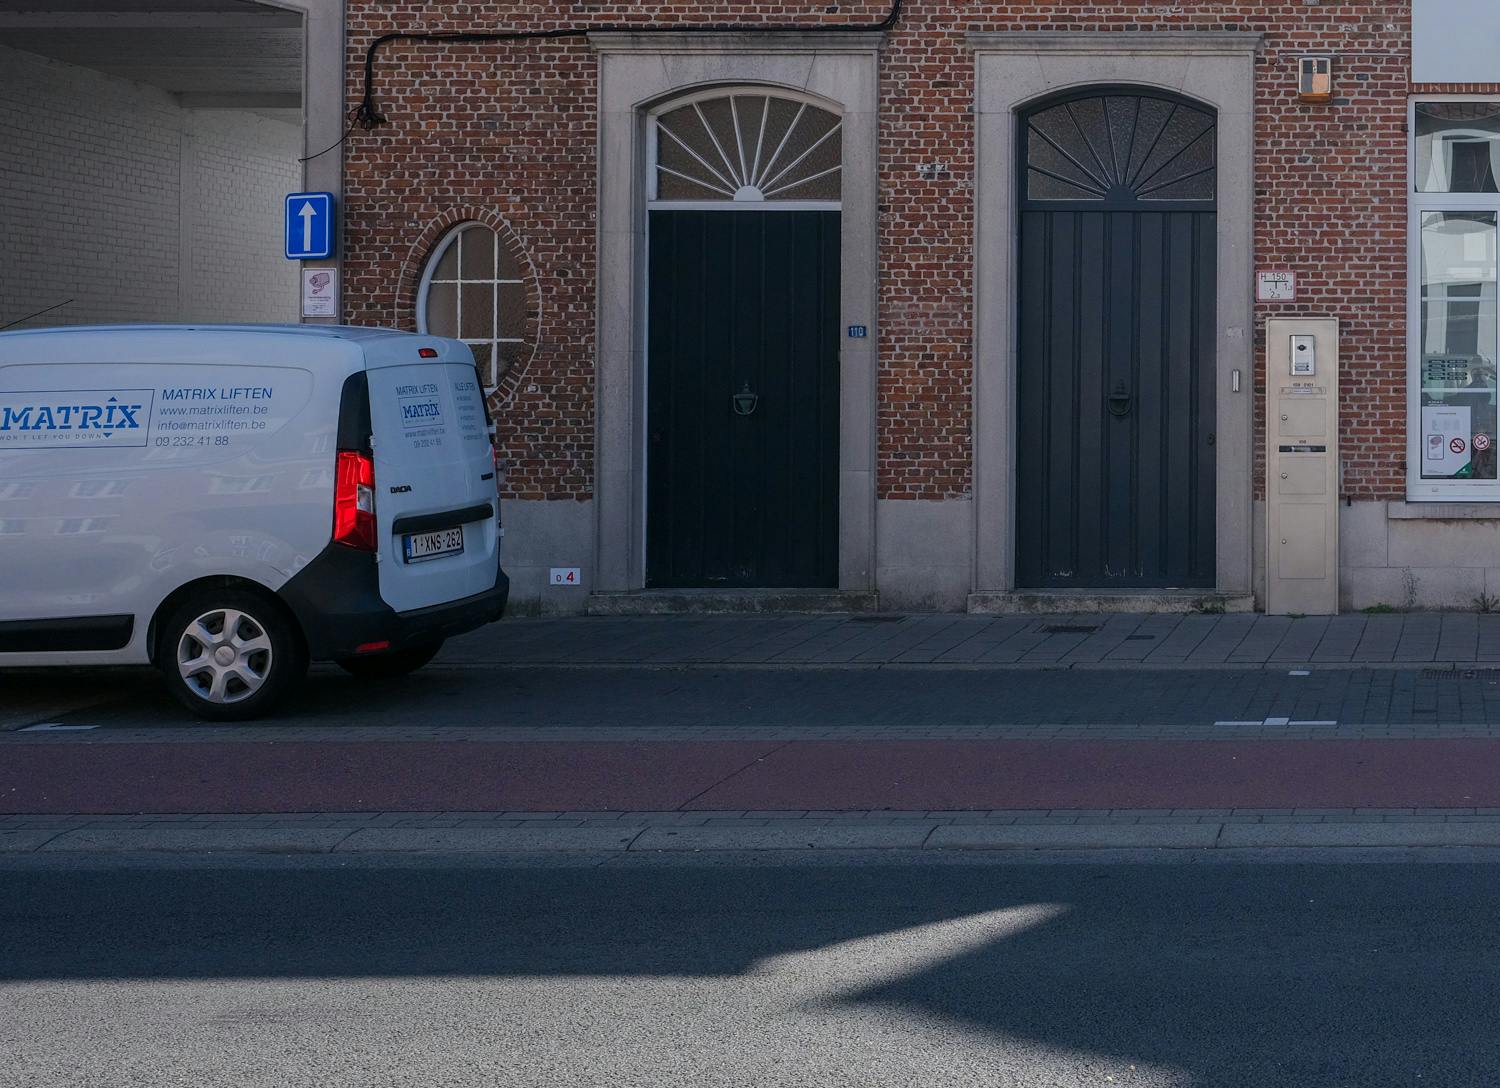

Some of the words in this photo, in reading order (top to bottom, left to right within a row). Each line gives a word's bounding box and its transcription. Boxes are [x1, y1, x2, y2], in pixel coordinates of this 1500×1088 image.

[1260, 272, 1267, 280] H
[1272, 272, 1287, 281] 150
[851, 326, 864, 337] 110
[162, 388, 217, 401] MATRIX
[220, 387, 273, 400] LIFTEN
[396, 385, 419, 396] MATRIX
[159, 404, 268, 416] www.matrixliften.be
[402, 403, 440, 419] MATRIX
[0, 404, 142, 431] MATRIX
[157, 420, 266, 431] info@matrixliften.be
[155, 436, 170, 447] 09
[172, 436, 194, 447] 232
[197, 436, 211, 446] 41
[214, 435, 229, 446] 88
[390, 485, 412, 494] DACIA
[413, 531, 461, 554] 1-XNS-262
[566, 571, 574, 582] 4
